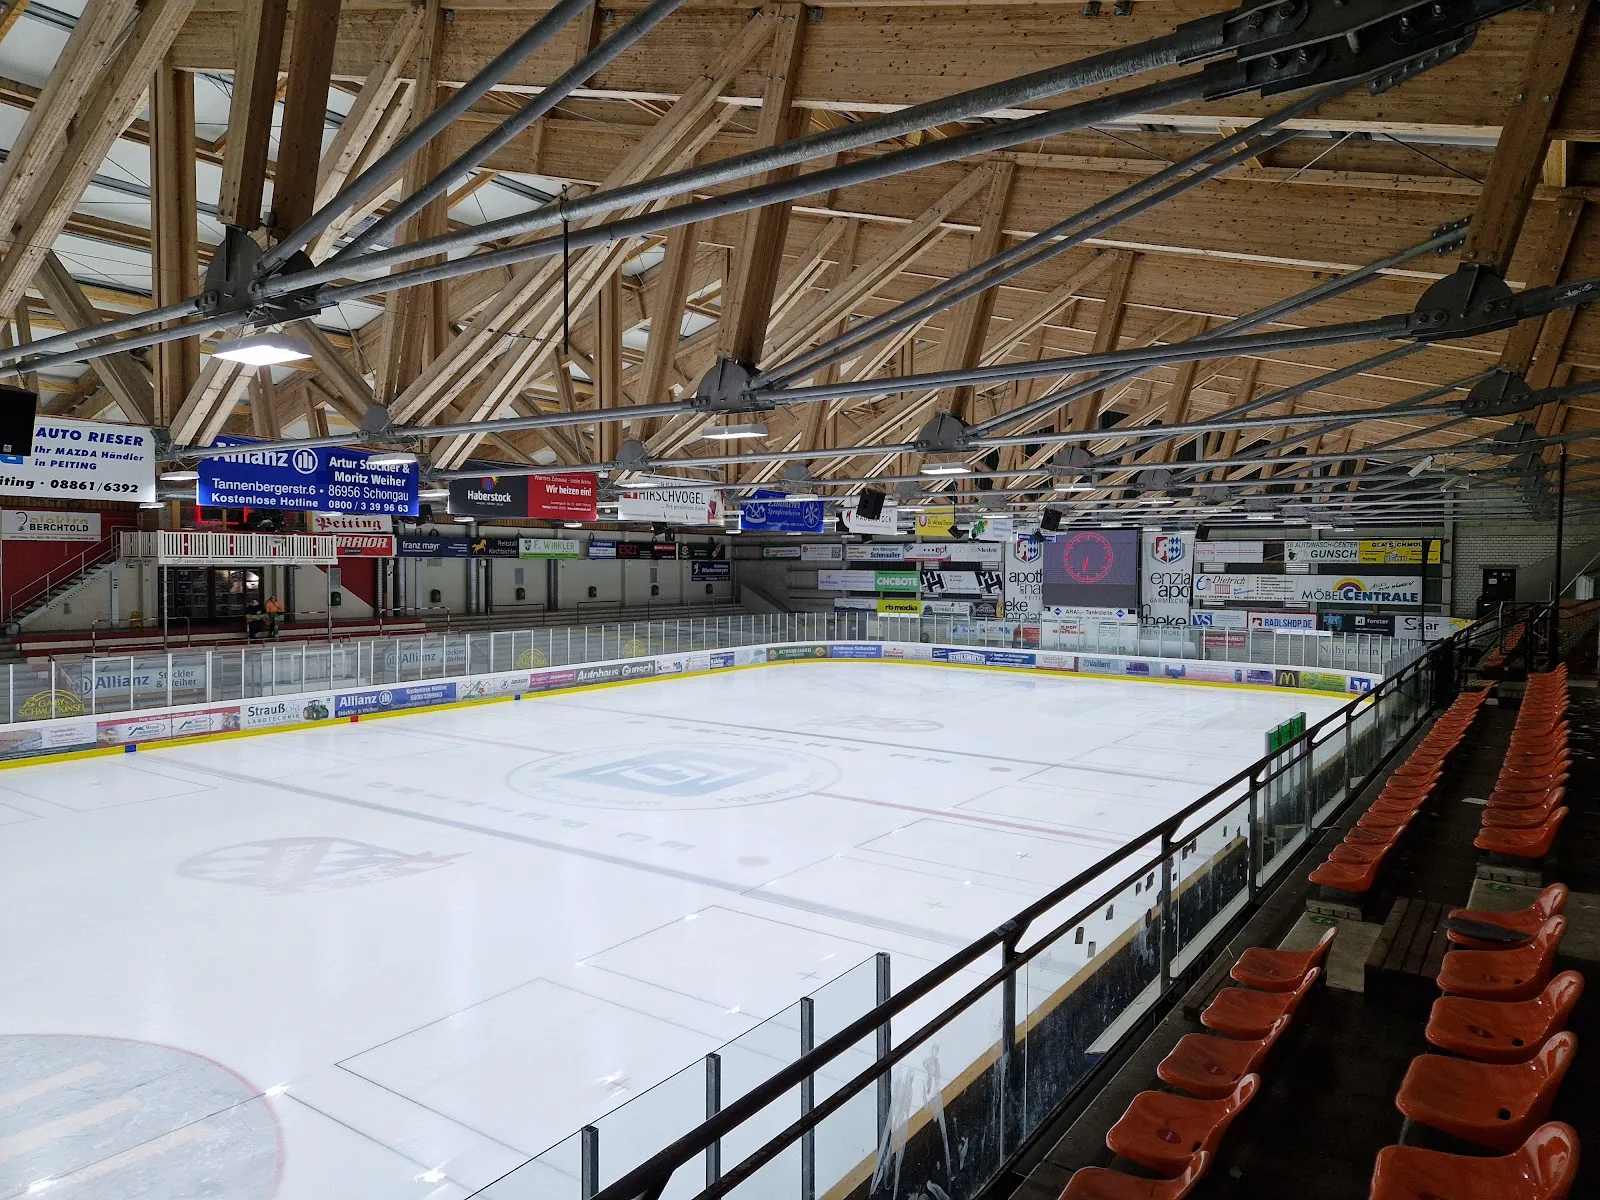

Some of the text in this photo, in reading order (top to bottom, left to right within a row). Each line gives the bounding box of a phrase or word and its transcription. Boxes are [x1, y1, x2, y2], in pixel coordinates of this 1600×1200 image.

[35, 427, 144, 446] AUTO RIESER
[34, 445, 144, 462] Ihr MAZDA Händler
[34, 459, 97, 470] in PEITING
[329, 456, 357, 469] Artur
[402, 463, 410, 474] &
[334, 471, 407, 487] Moritz Weiher
[50, 479, 139, 493] 08861/6392
[545, 484, 592, 497] Wir heizen ein!
[328, 484, 361, 498] 86956
[363, 487, 409, 502] Schongau
[467, 490, 512, 503] Haberstock
[212, 493, 277, 506] Kostenlose
[280, 497, 319, 508] Hotline
[328, 500, 352, 510] 0800
[360, 502, 367, 510] 3
[369, 502, 381, 511] 39
[383, 503, 395, 512] 96
[397, 504, 409, 513] 63
[29, 523, 89, 532] BERCHTOLD
[315, 517, 382, 532] Peiting
[402, 540, 423, 550] franz
[422, 542, 441, 552] mayr
[543, 540, 575, 550] WINKLER
[1310, 549, 1358, 559] GUNSCH
[876, 576, 919, 587] CNCBOTE
[1212, 575, 1246, 585] Dietrich
[894, 604, 918, 612] media
[1192, 614, 1213, 627] VS
[1264, 618, 1313, 629] RADLSHOP.DE
[401, 651, 436, 664] Allianz
[1089, 660, 1112, 669] Vaillant
[577, 667, 620, 682] Autohaus
[622, 663, 654, 677] Gunsch
[94, 675, 150, 690] Allianz
[339, 695, 377, 708] Allianz
[248, 703, 286, 717] Strauß
[247, 713, 300, 725] LANDTECHNIK
